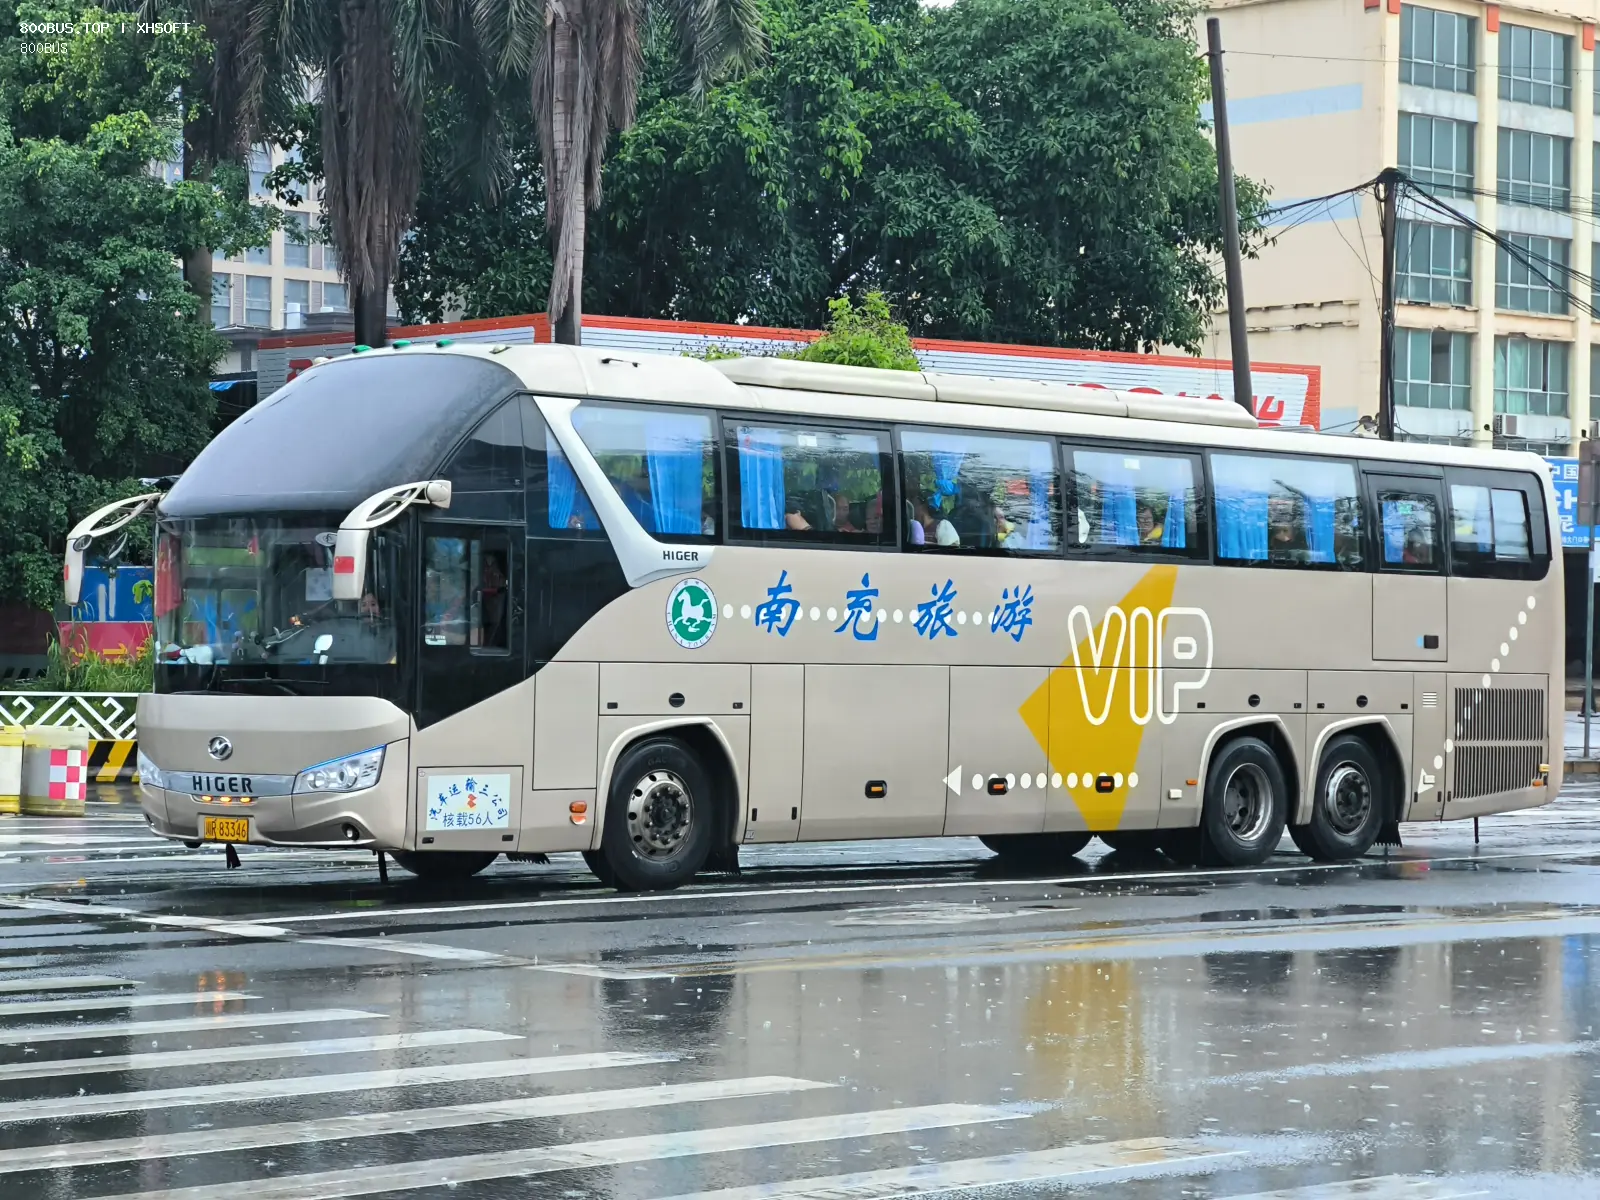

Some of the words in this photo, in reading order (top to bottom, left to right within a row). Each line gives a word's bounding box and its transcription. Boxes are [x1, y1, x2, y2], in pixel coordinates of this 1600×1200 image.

[662, 550, 699, 561] HIGER
[754, 569, 1034, 642] 南充旅游
[1067, 605, 1214, 726] VIP
[192, 775, 254, 793] HIGER
[442, 811, 494, 828] 核载56人
